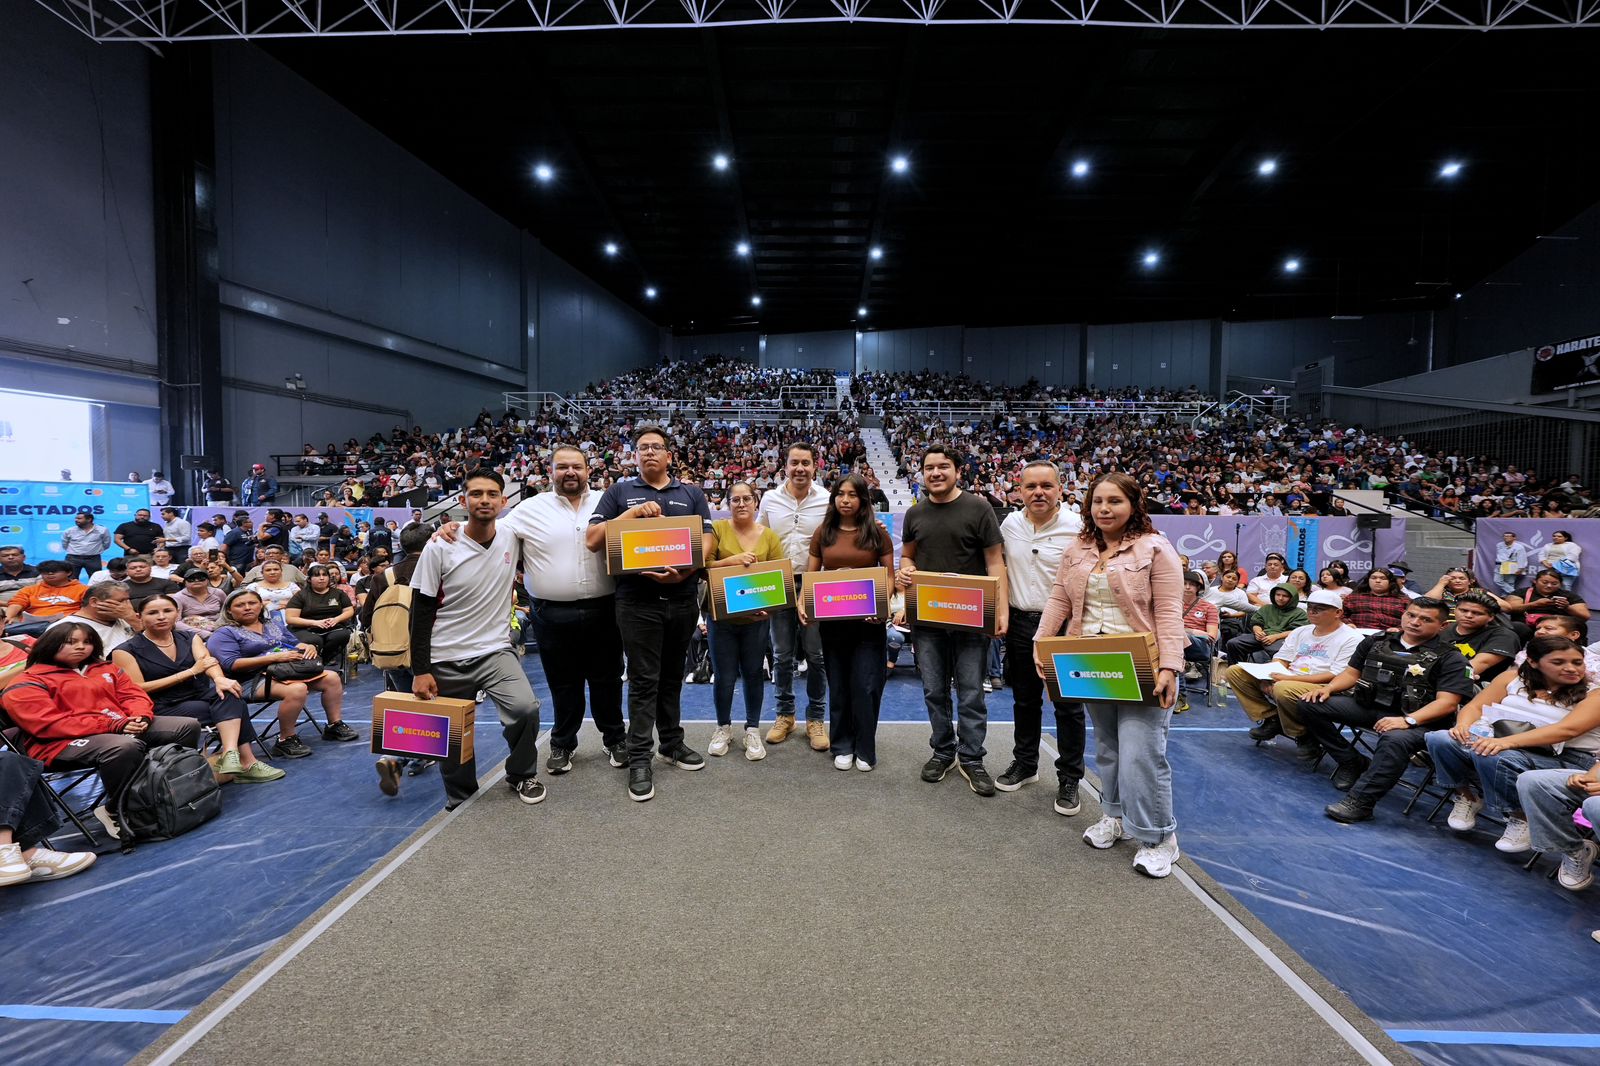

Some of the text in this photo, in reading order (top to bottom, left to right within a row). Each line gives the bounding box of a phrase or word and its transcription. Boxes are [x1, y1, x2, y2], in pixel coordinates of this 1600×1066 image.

[634, 544, 686, 554] CONECTADOS
[1297, 527, 1306, 569] ECTADOS
[736, 585, 776, 596] CONECTADOS
[822, 594, 868, 603] CONECTADOS
[928, 601, 978, 611] CONECTADOS
[1069, 670, 1123, 678] CONECTADOS
[392, 725, 441, 739] CONECTADOS
